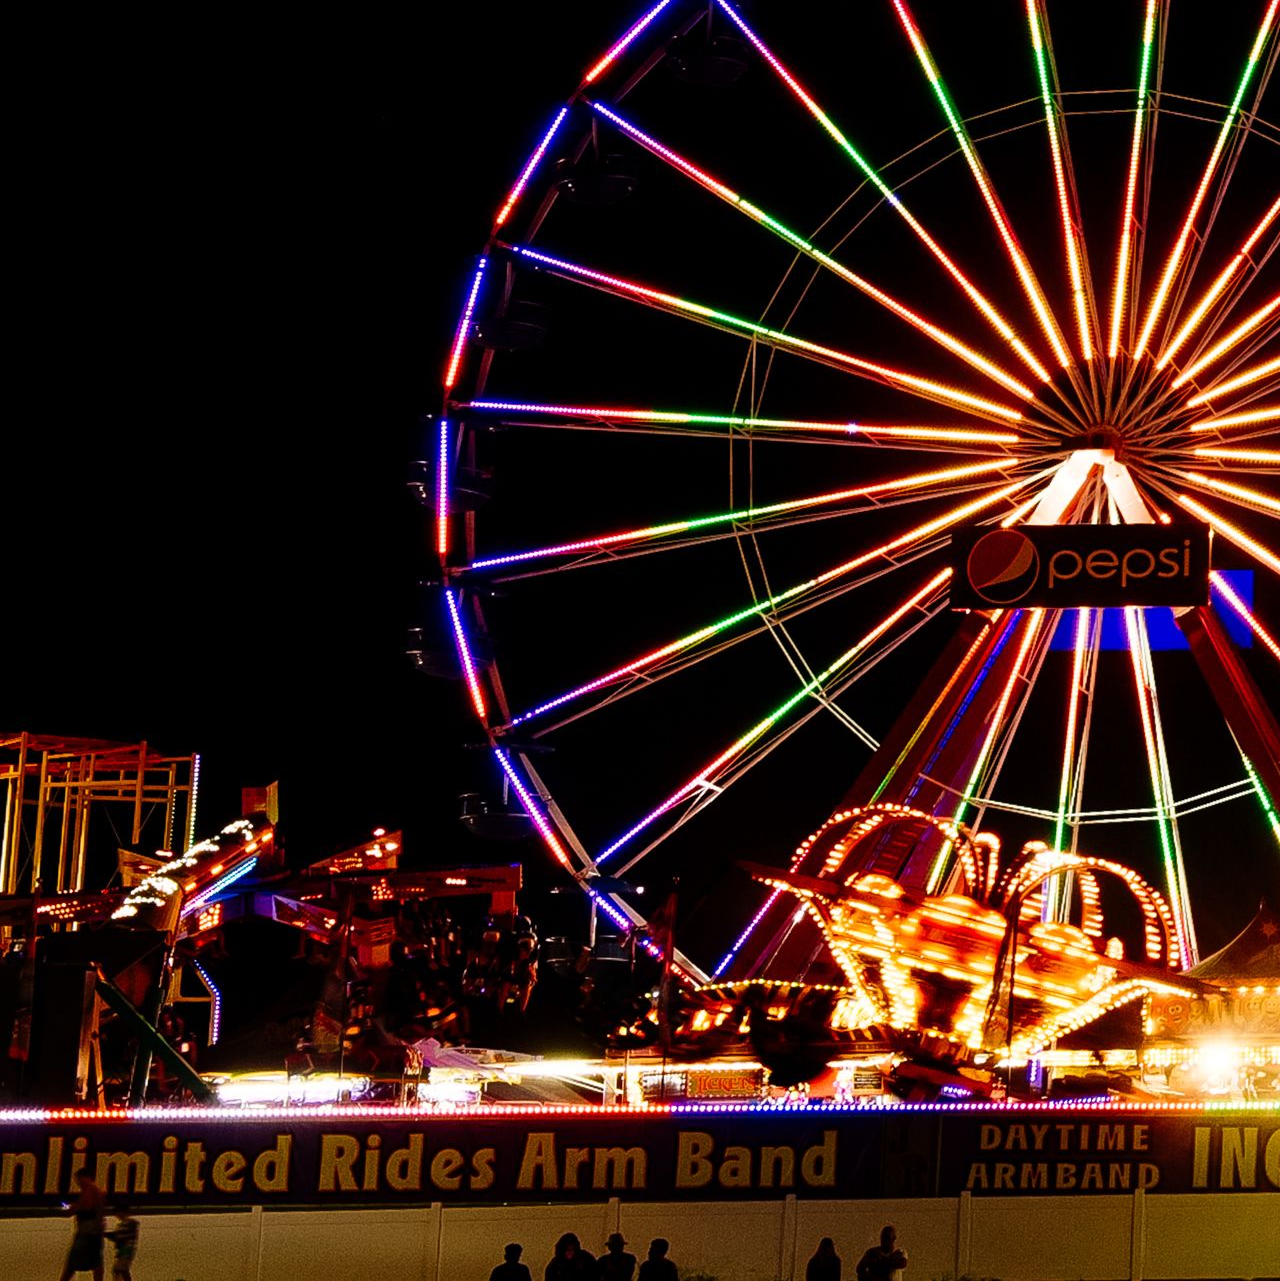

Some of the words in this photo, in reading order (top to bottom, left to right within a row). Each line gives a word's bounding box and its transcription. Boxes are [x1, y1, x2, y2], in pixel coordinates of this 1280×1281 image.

[1048, 539, 1192, 589] pepsi
[979, 1123, 1150, 1152] DAYTIME
[317, 1133, 494, 1192] Rides
[518, 1132, 648, 1191] Arm
[674, 1130, 840, 1189] Band
[966, 1161, 1161, 1191] ARMBAND
